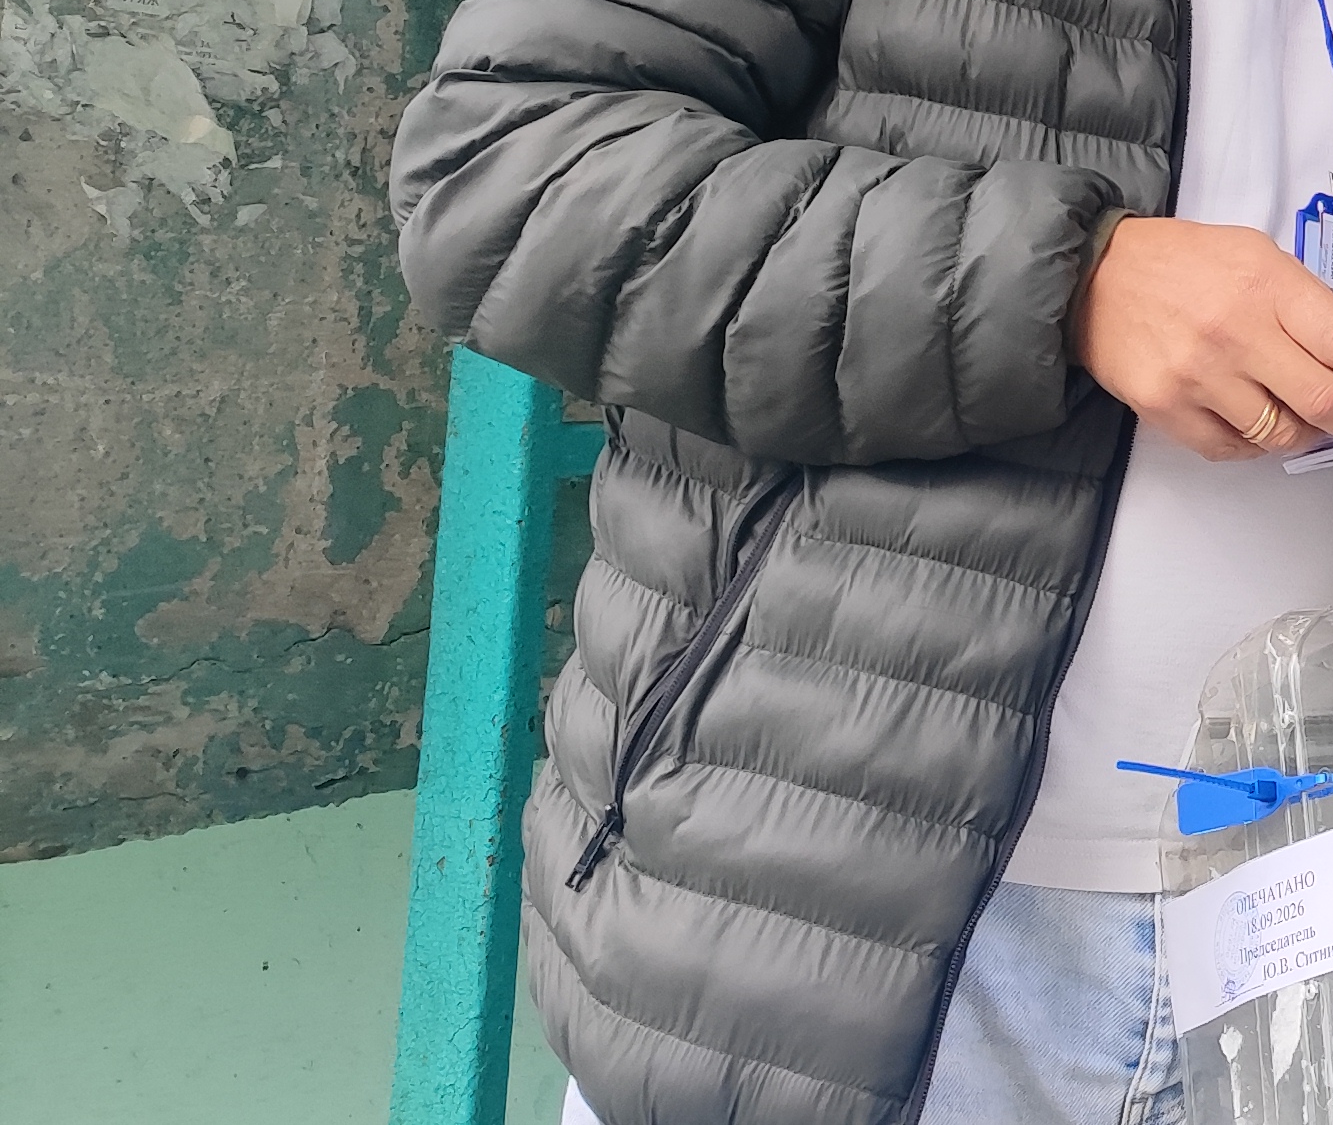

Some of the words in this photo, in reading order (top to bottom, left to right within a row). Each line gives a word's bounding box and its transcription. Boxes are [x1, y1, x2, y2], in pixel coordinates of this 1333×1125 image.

[1236, 870, 1316, 916] ОПЕЧАТАНО
[1247, 899, 1305, 936] 18.09.2026
[1239, 925, 1317, 967] Председатель
[1262, 957, 1293, 982] Ю.В.
